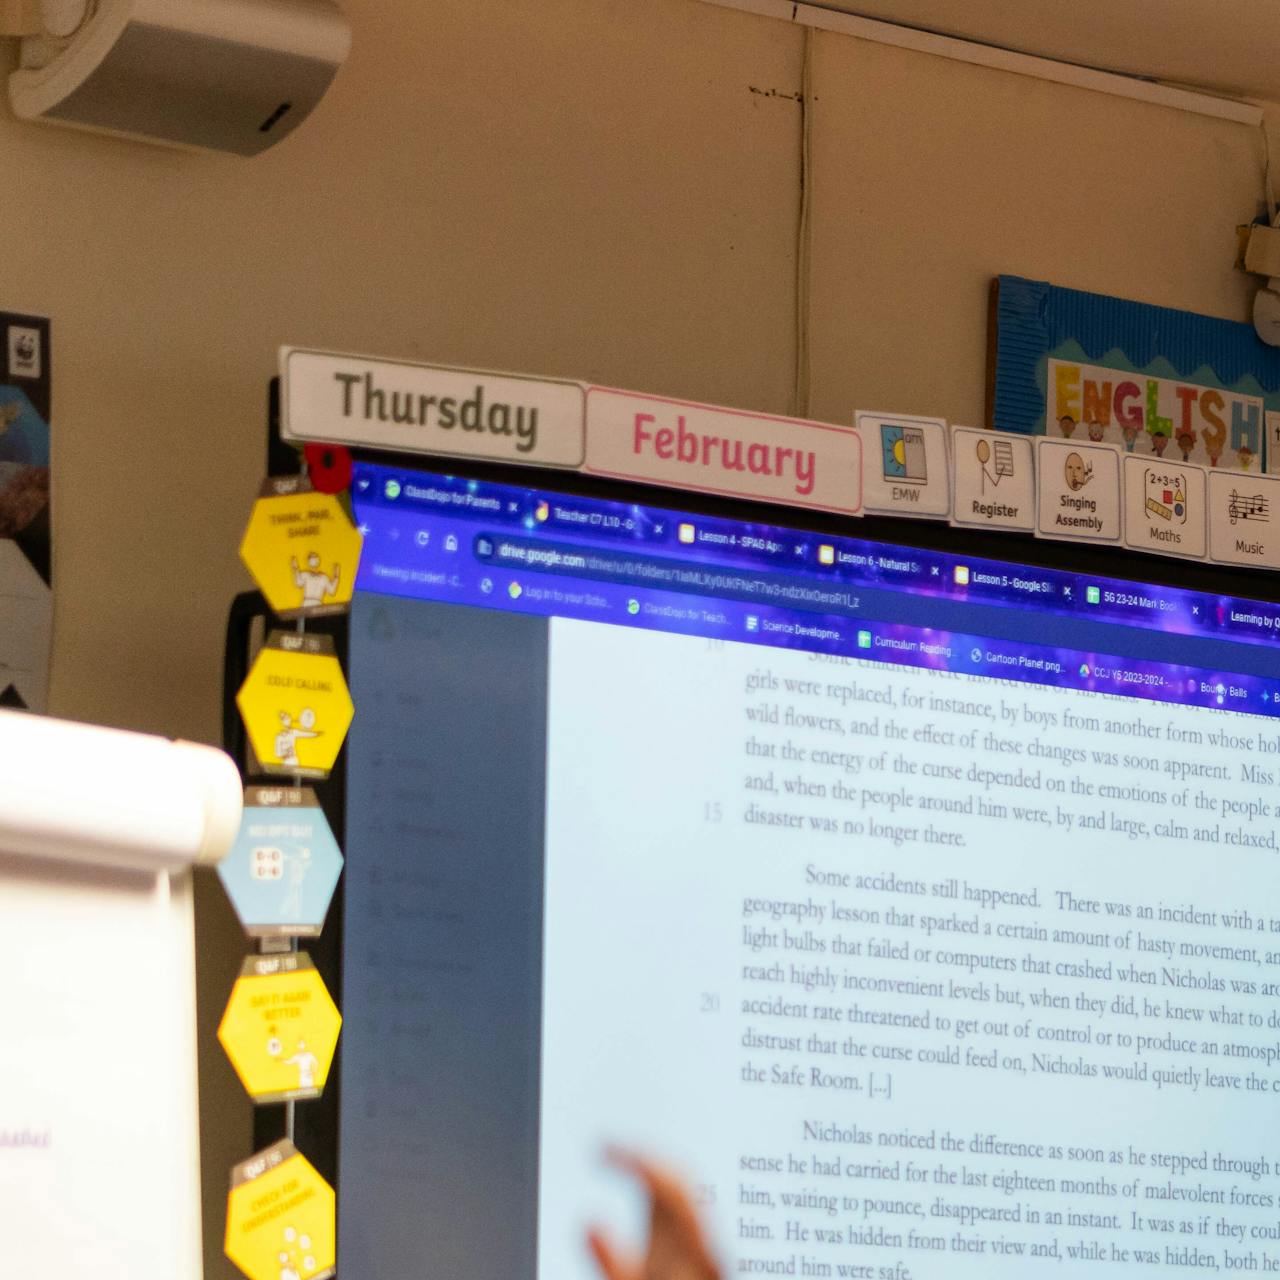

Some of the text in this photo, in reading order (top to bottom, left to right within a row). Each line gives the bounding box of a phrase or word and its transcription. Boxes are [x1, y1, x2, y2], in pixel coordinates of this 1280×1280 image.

[334, 372, 539, 452] Thursday
[1055, 364, 1260, 452] ENGLISH
[633, 413, 816, 494] February
[1151, 474, 1180, 488] 2+3=5
[893, 488, 920, 502] EMW
[1060, 495, 1096, 511] Singing
[972, 501, 1018, 518] Register
[1056, 514, 1103, 532] Assembly
[700, 531, 764, 548] Lesson 4 SPAG
[1150, 528, 1181, 544] Maths
[1236, 541, 1264, 555] Music
[839, 551, 909, 572] Lesson 6 Natural
[973, 573, 1041, 592] Lesson 5 Google
[1117, 592, 1138, 606] 23-24
[763, 620, 792, 635] Science
[1231, 611, 1261, 627] Learning
[1262, 616, 1273, 628] by
[986, 652, 1043, 670] Cartoon Planet
[1124, 670, 1164, 685] 2023-2024
[744, 701, 779, 725] wild
[784, 706, 845, 736] flowers,
[850, 714, 879, 737] and
[883, 718, 908, 740] the
[912, 721, 955, 746] effect
[958, 727, 976, 748] of
[983, 730, 1023, 754] these
[1026, 735, 1087, 767] changes
[1090, 749, 1119, 765] was
[1123, 753, 1159, 770] soon
[1163, 755, 1231, 784] apparent.
[1241, 761, 1274, 784] Miss
[805, 863, 850, 887] Some
[855, 868, 927, 895] accidents
[931, 877, 958, 899] still
[963, 880, 1041, 913] happened.
[1054, 890, 1100, 914] There
[1104, 901, 1132, 917] was
[1136, 905, 1154, 919] an
[1158, 901, 1217, 926] incident
[1221, 907, 1253, 929] with
[1256, 917, 1265, 931] a
[803, 1120, 873, 1144] Nicholas
[878, 1125, 936, 1149] noticed
[940, 1130, 965, 1151] the
[968, 1132, 1044, 1157] difference
[1048, 1144, 1063, 1158] as
[1067, 1146, 1104, 1161] soon
[1108, 1149, 1123, 1162] as
[1128, 1144, 1146, 1164] he
[1150, 1146, 1207, 1174] stepped
[1212, 1151, 1270, 1178] through
